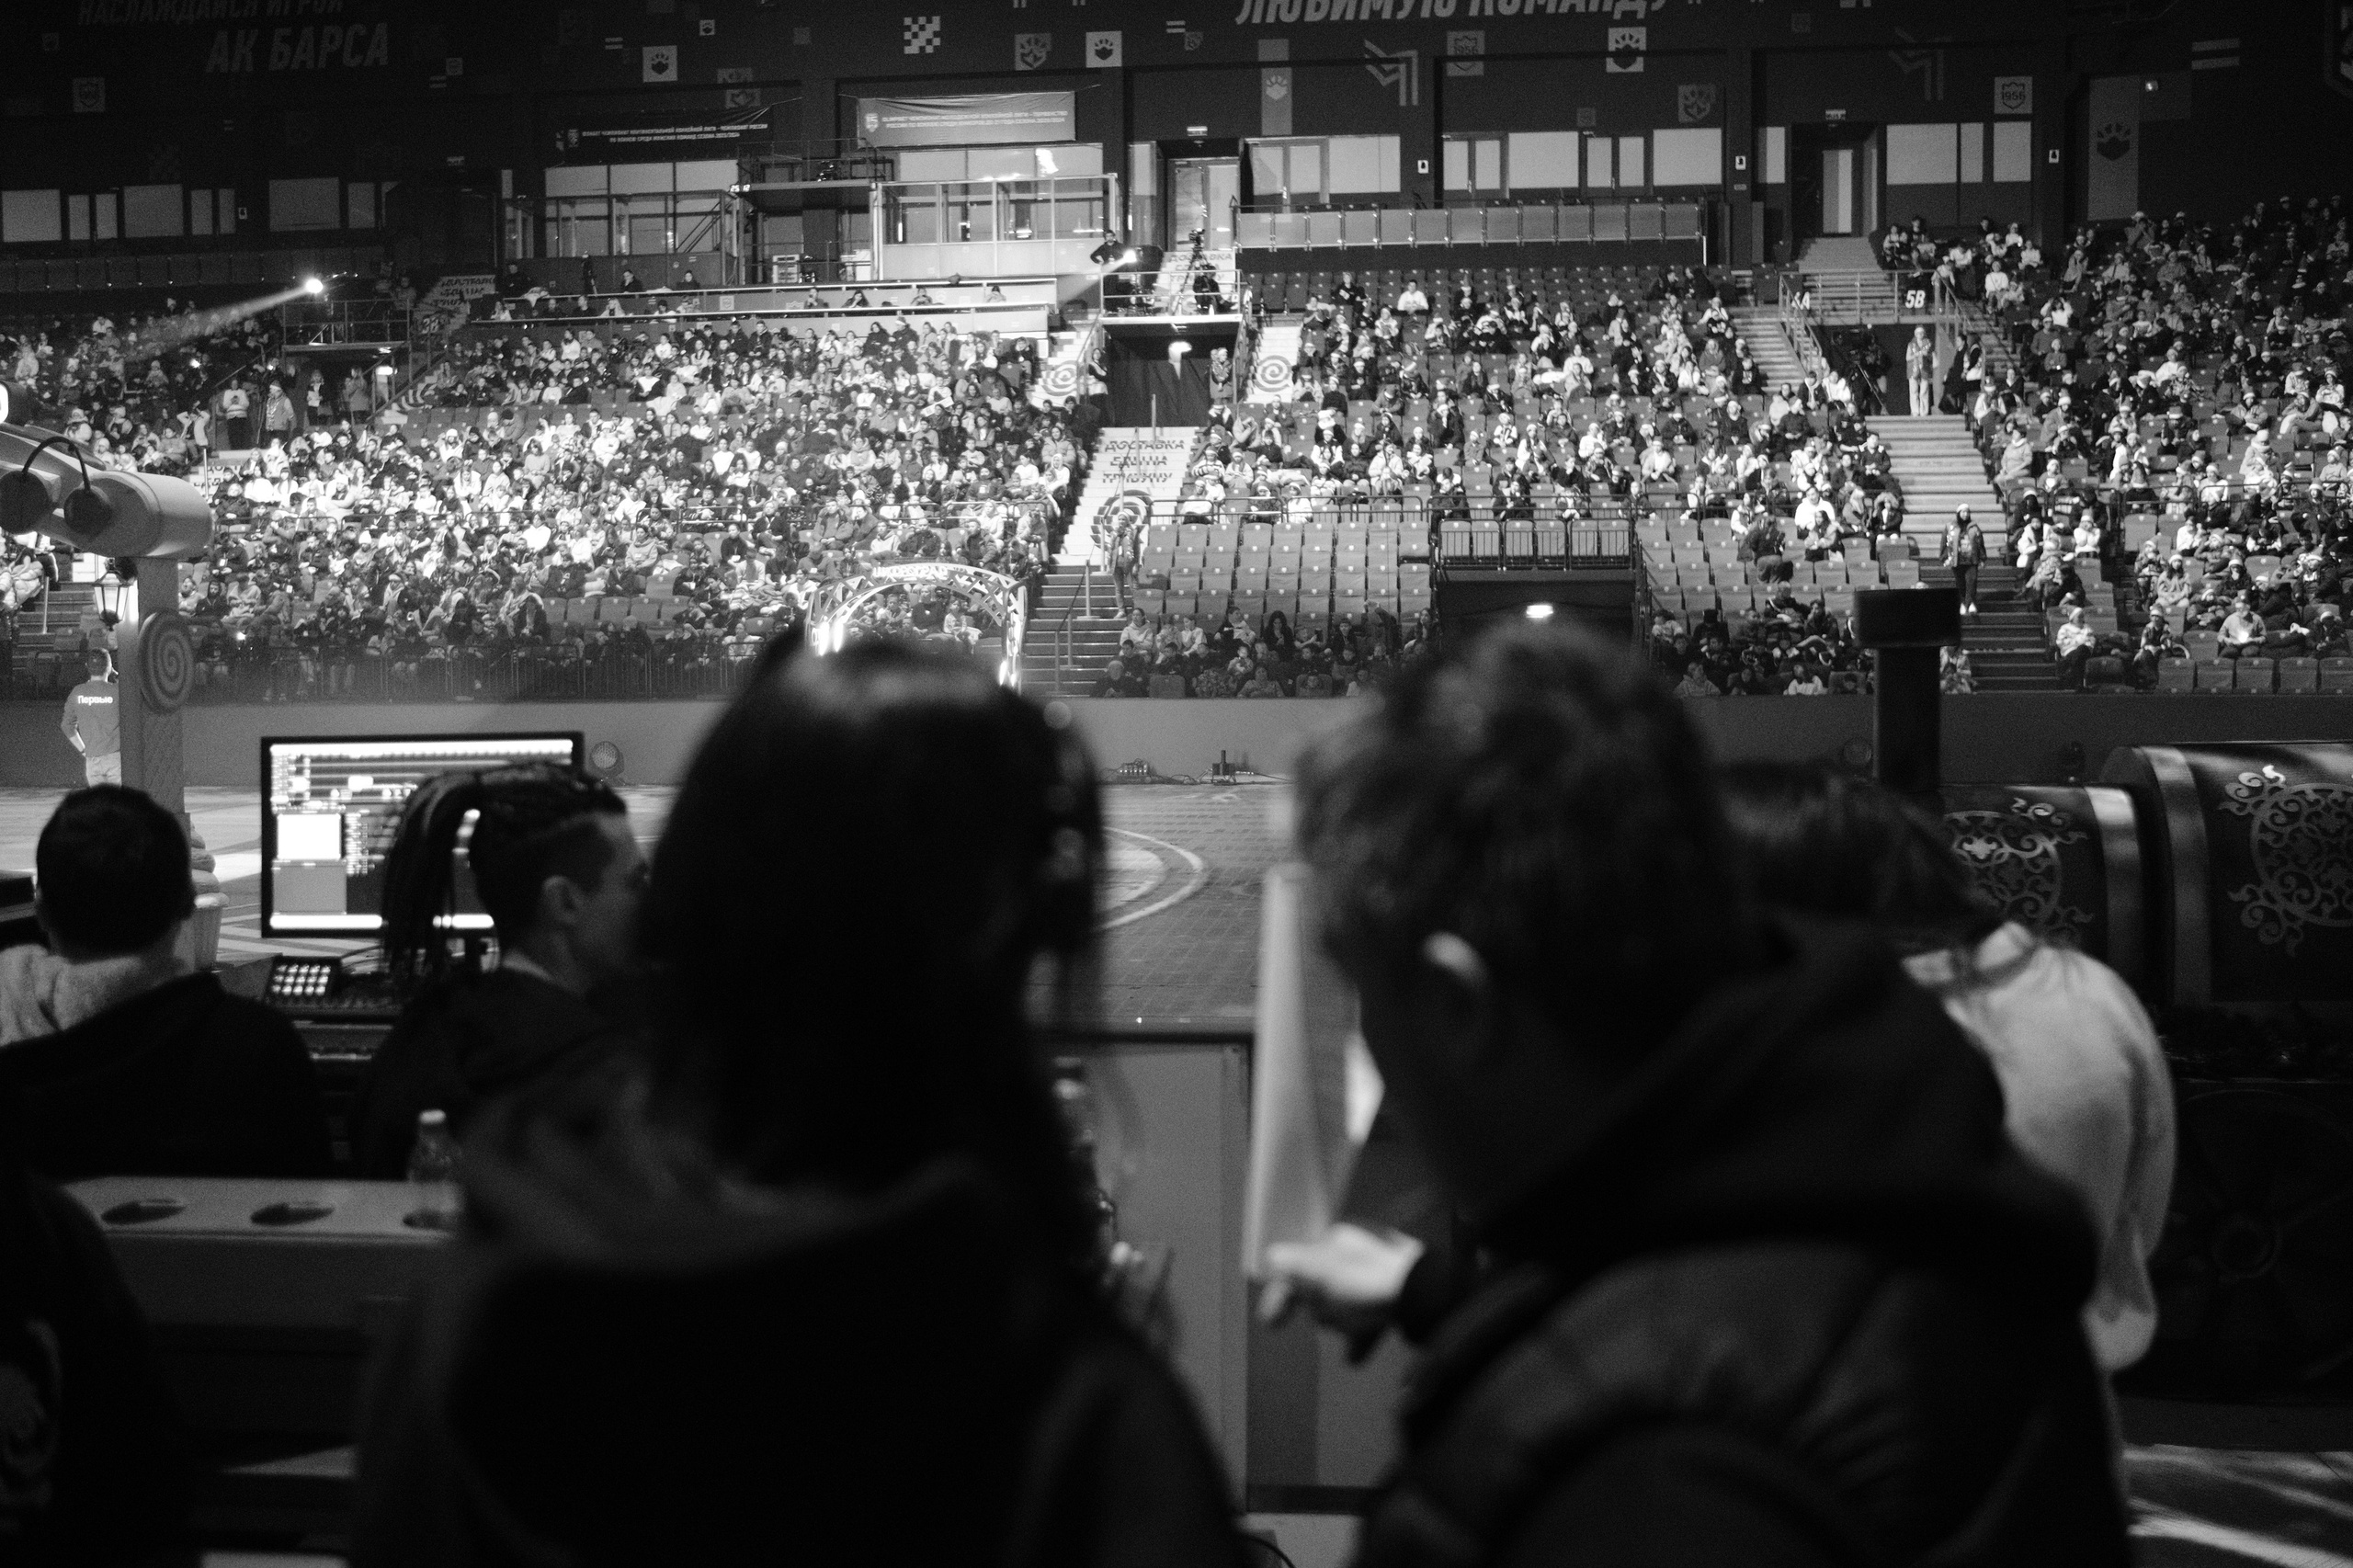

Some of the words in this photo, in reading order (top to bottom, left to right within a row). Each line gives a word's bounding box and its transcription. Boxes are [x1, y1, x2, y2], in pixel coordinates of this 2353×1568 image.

[205, 28, 259, 73] АК
[268, 22, 388, 71] БАРСА
[1105, 440, 1185, 452] ДОСТАВКА
[1145, 456, 1167, 465] НА
[1103, 472, 1173, 483] ТРИБУНУ
[78, 695, 113, 706] Первые
